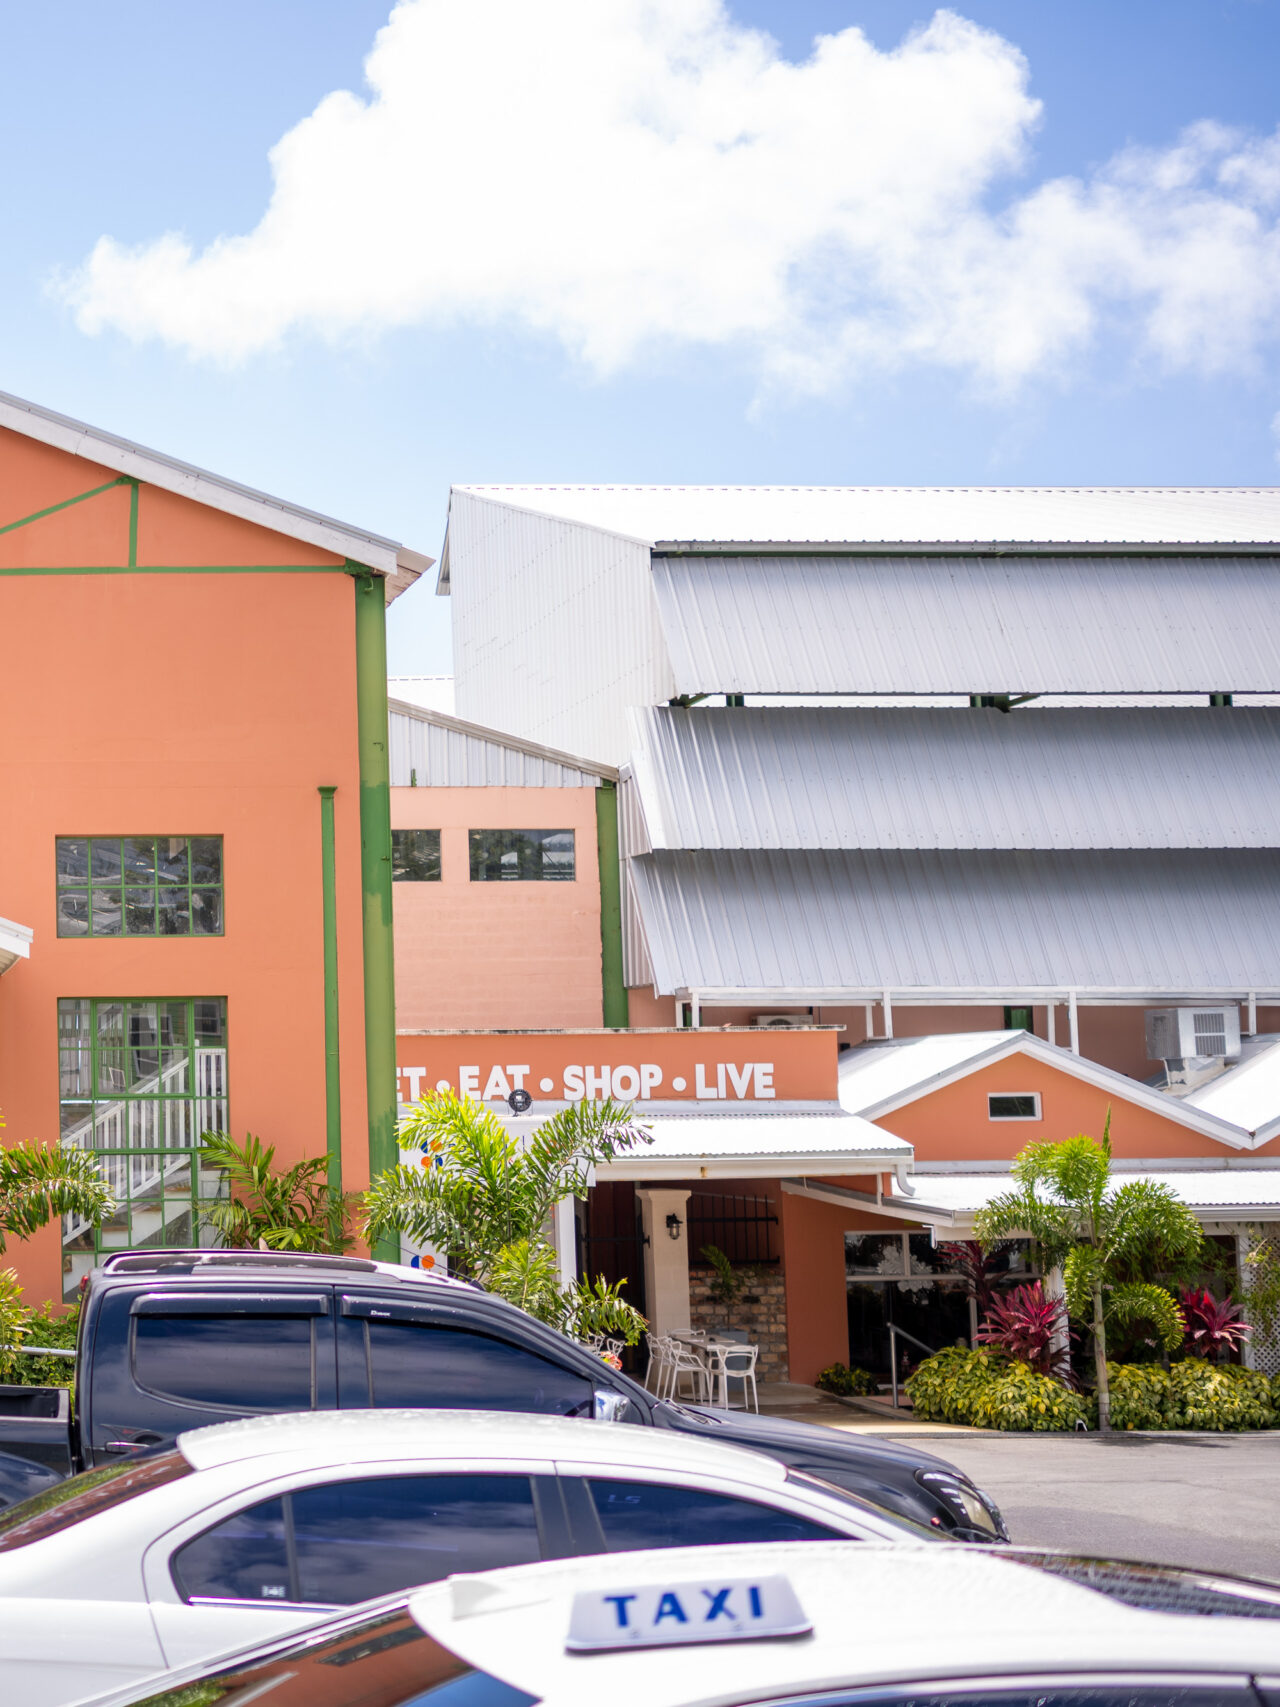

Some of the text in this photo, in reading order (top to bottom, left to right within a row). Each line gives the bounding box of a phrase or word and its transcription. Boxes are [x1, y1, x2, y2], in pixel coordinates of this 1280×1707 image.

[459, 1065, 531, 1101] EAT
[563, 1063, 663, 1101] SHOP
[695, 1062, 776, 1099] LIVE
[602, 1585, 764, 1628] TAXI
